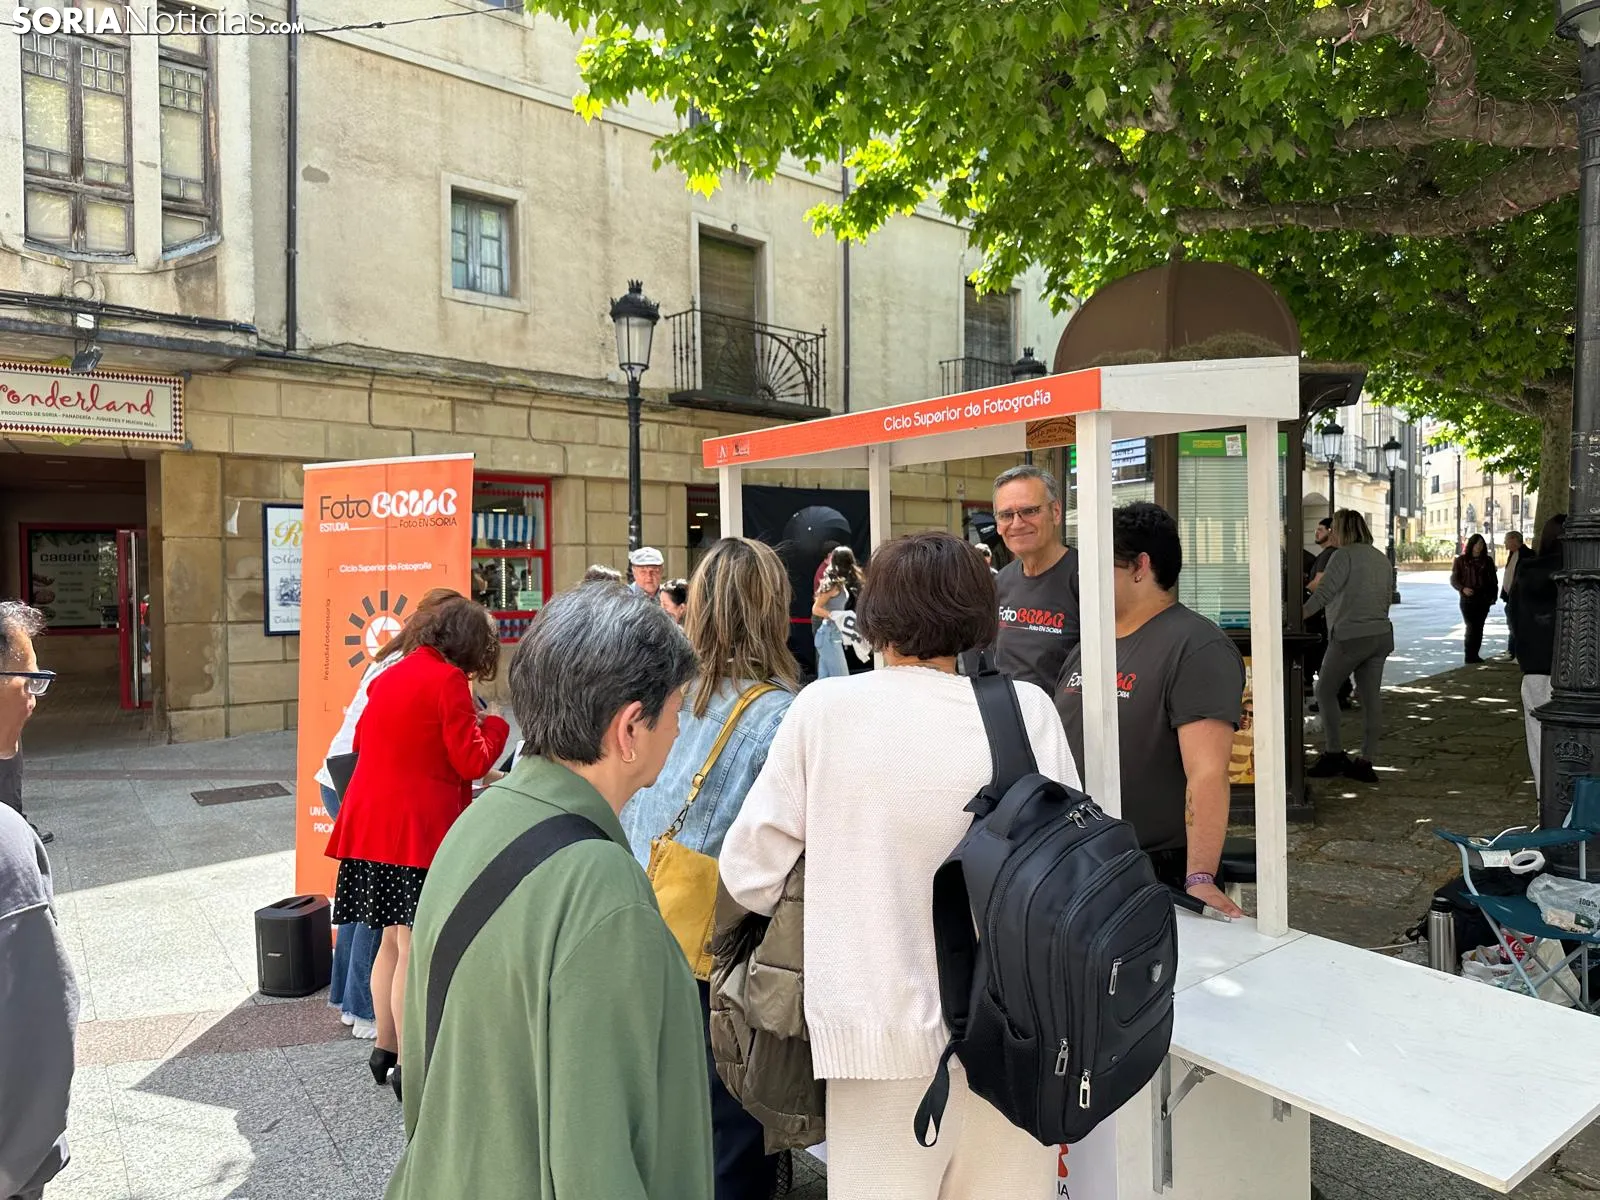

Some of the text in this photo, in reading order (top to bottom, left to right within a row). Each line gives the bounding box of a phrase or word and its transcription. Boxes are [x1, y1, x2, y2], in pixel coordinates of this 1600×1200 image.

[883, 389, 1051, 431] Ciclo Superior de Fotografía
[319, 517, 458, 532] ESTUDIA Foto EN SORIA
[339, 564, 358, 574] Ciclo
[358, 563, 386, 574] Superior
[387, 563, 397, 572] de
